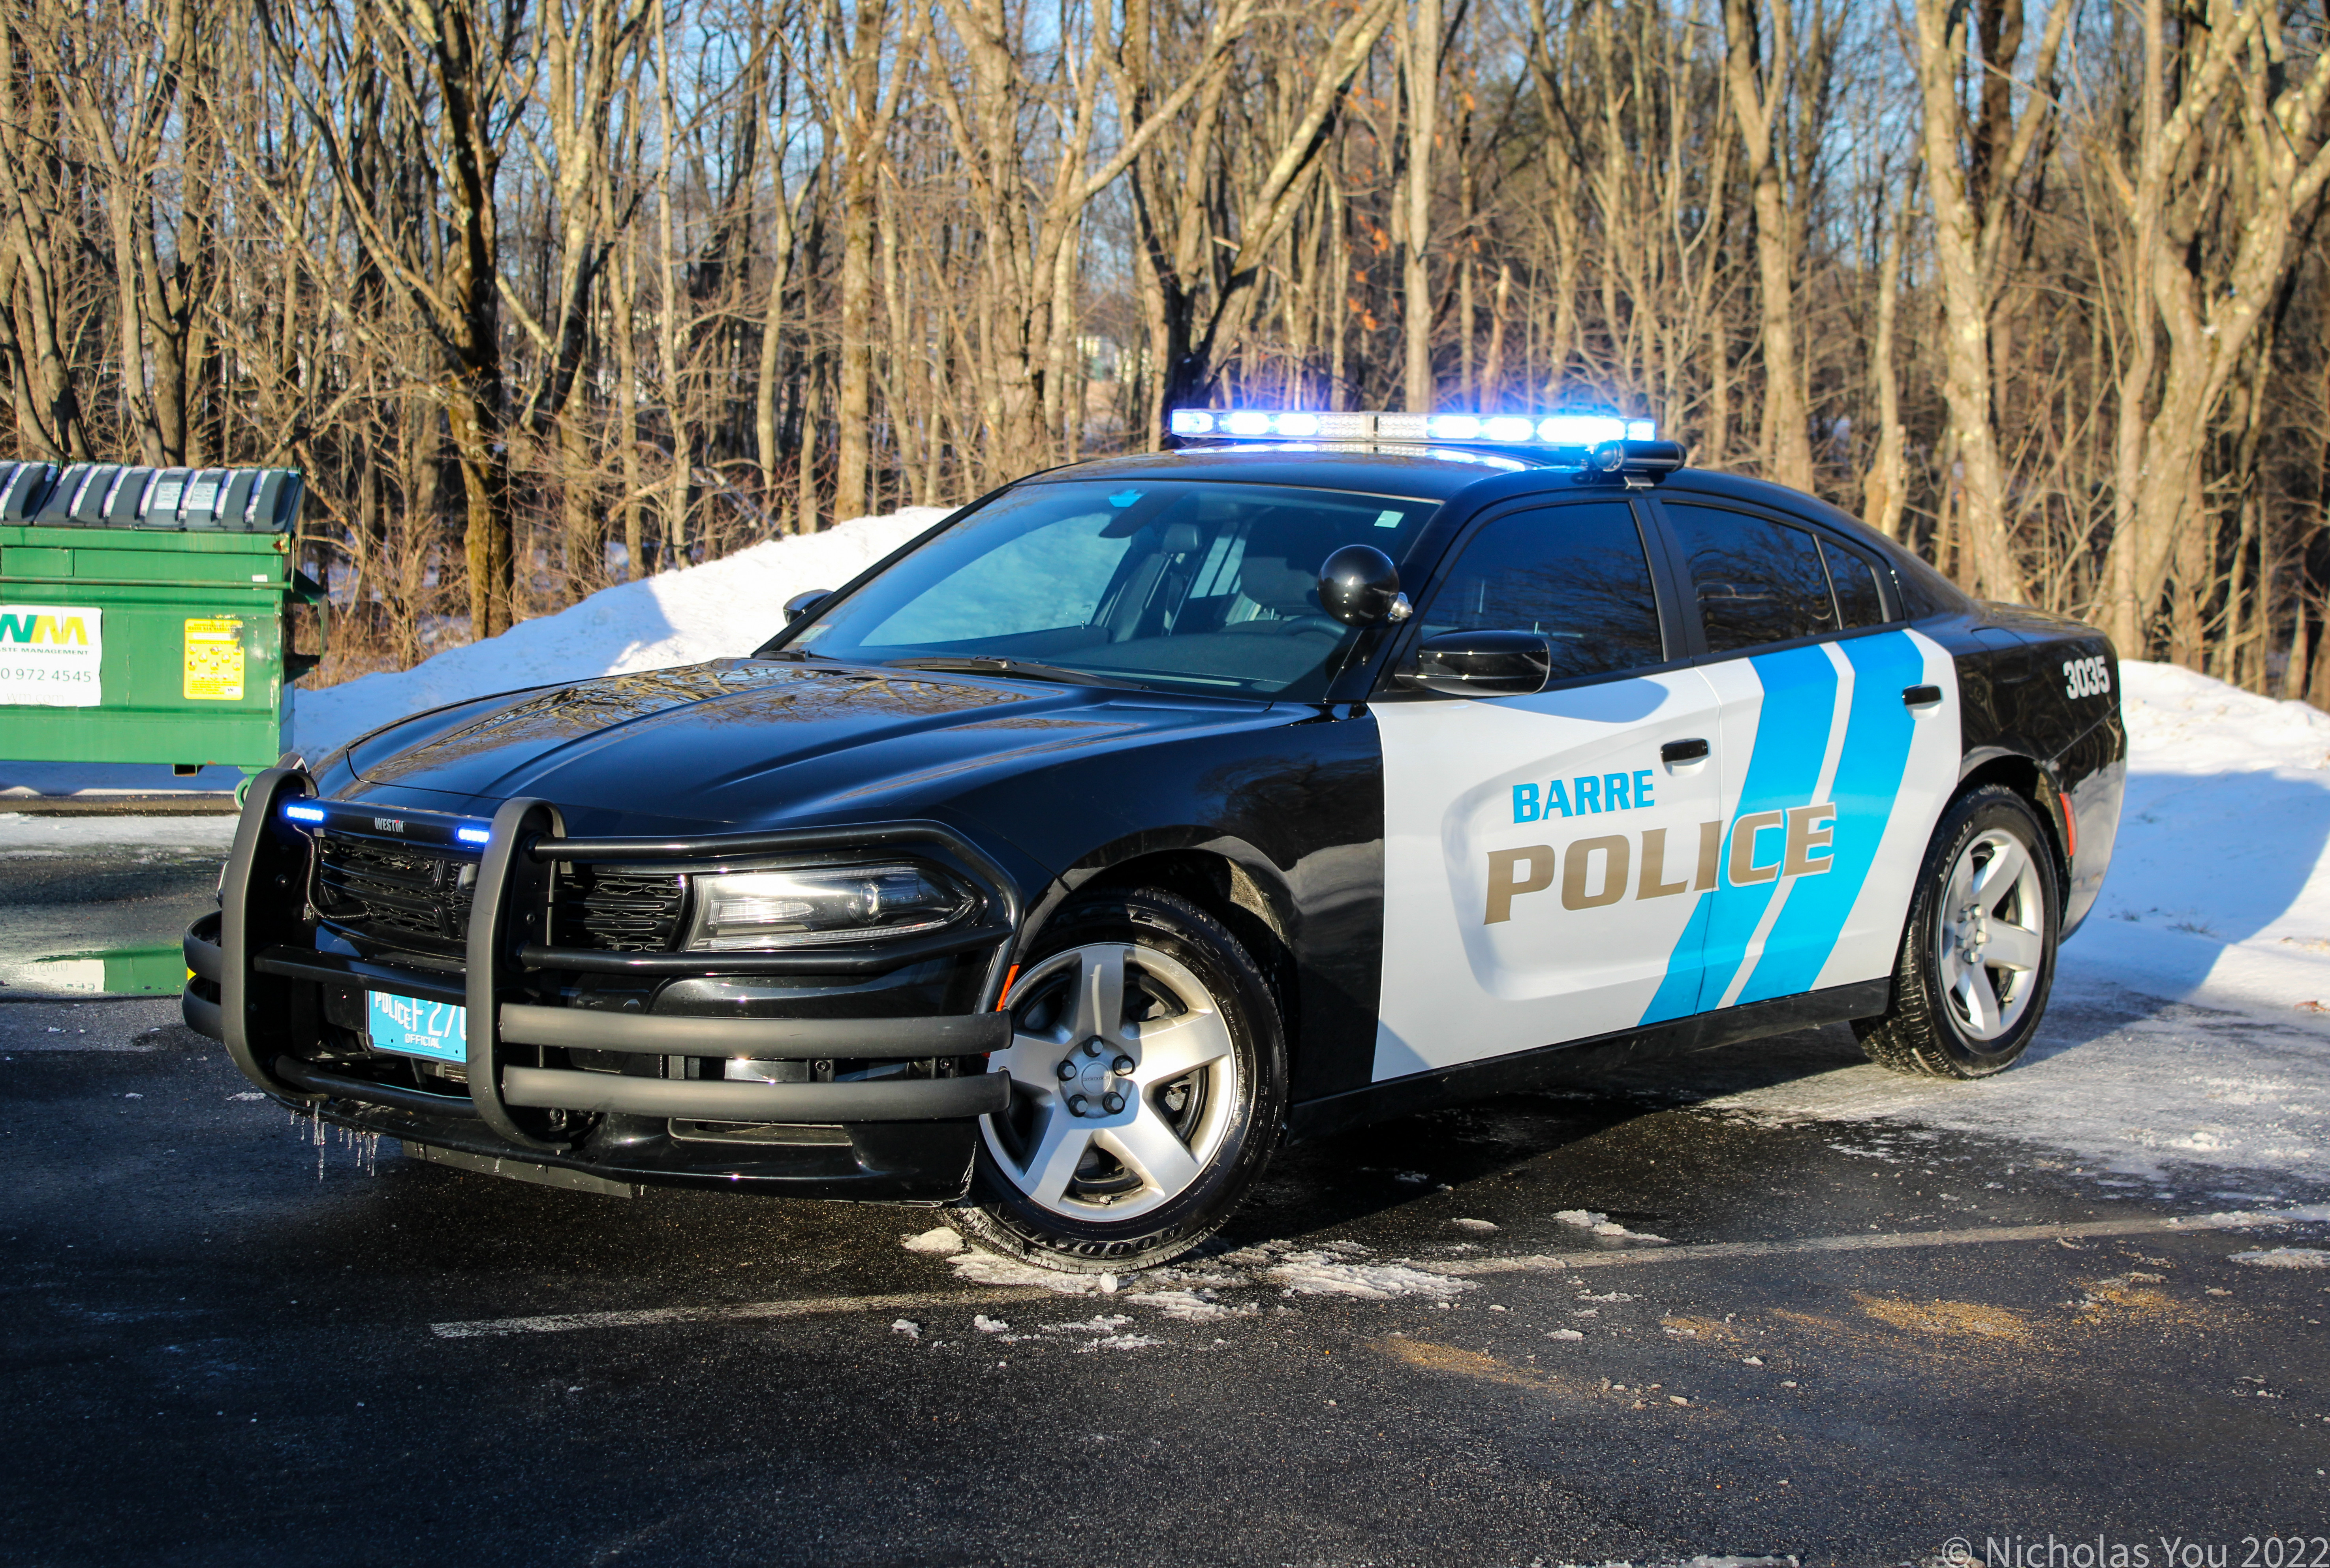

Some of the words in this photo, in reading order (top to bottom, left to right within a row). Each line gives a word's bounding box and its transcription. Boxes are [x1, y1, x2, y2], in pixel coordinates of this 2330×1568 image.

[16, 669, 45, 680] 972
[51, 670, 91, 682] 4545
[2063, 655, 2110, 700] 3035
[1513, 769, 1655, 824] BARRE
[1483, 802, 1836, 925] POLICE
[375, 992, 412, 1030] POLICE
[405, 1033, 442, 1049] OFFICIAL
